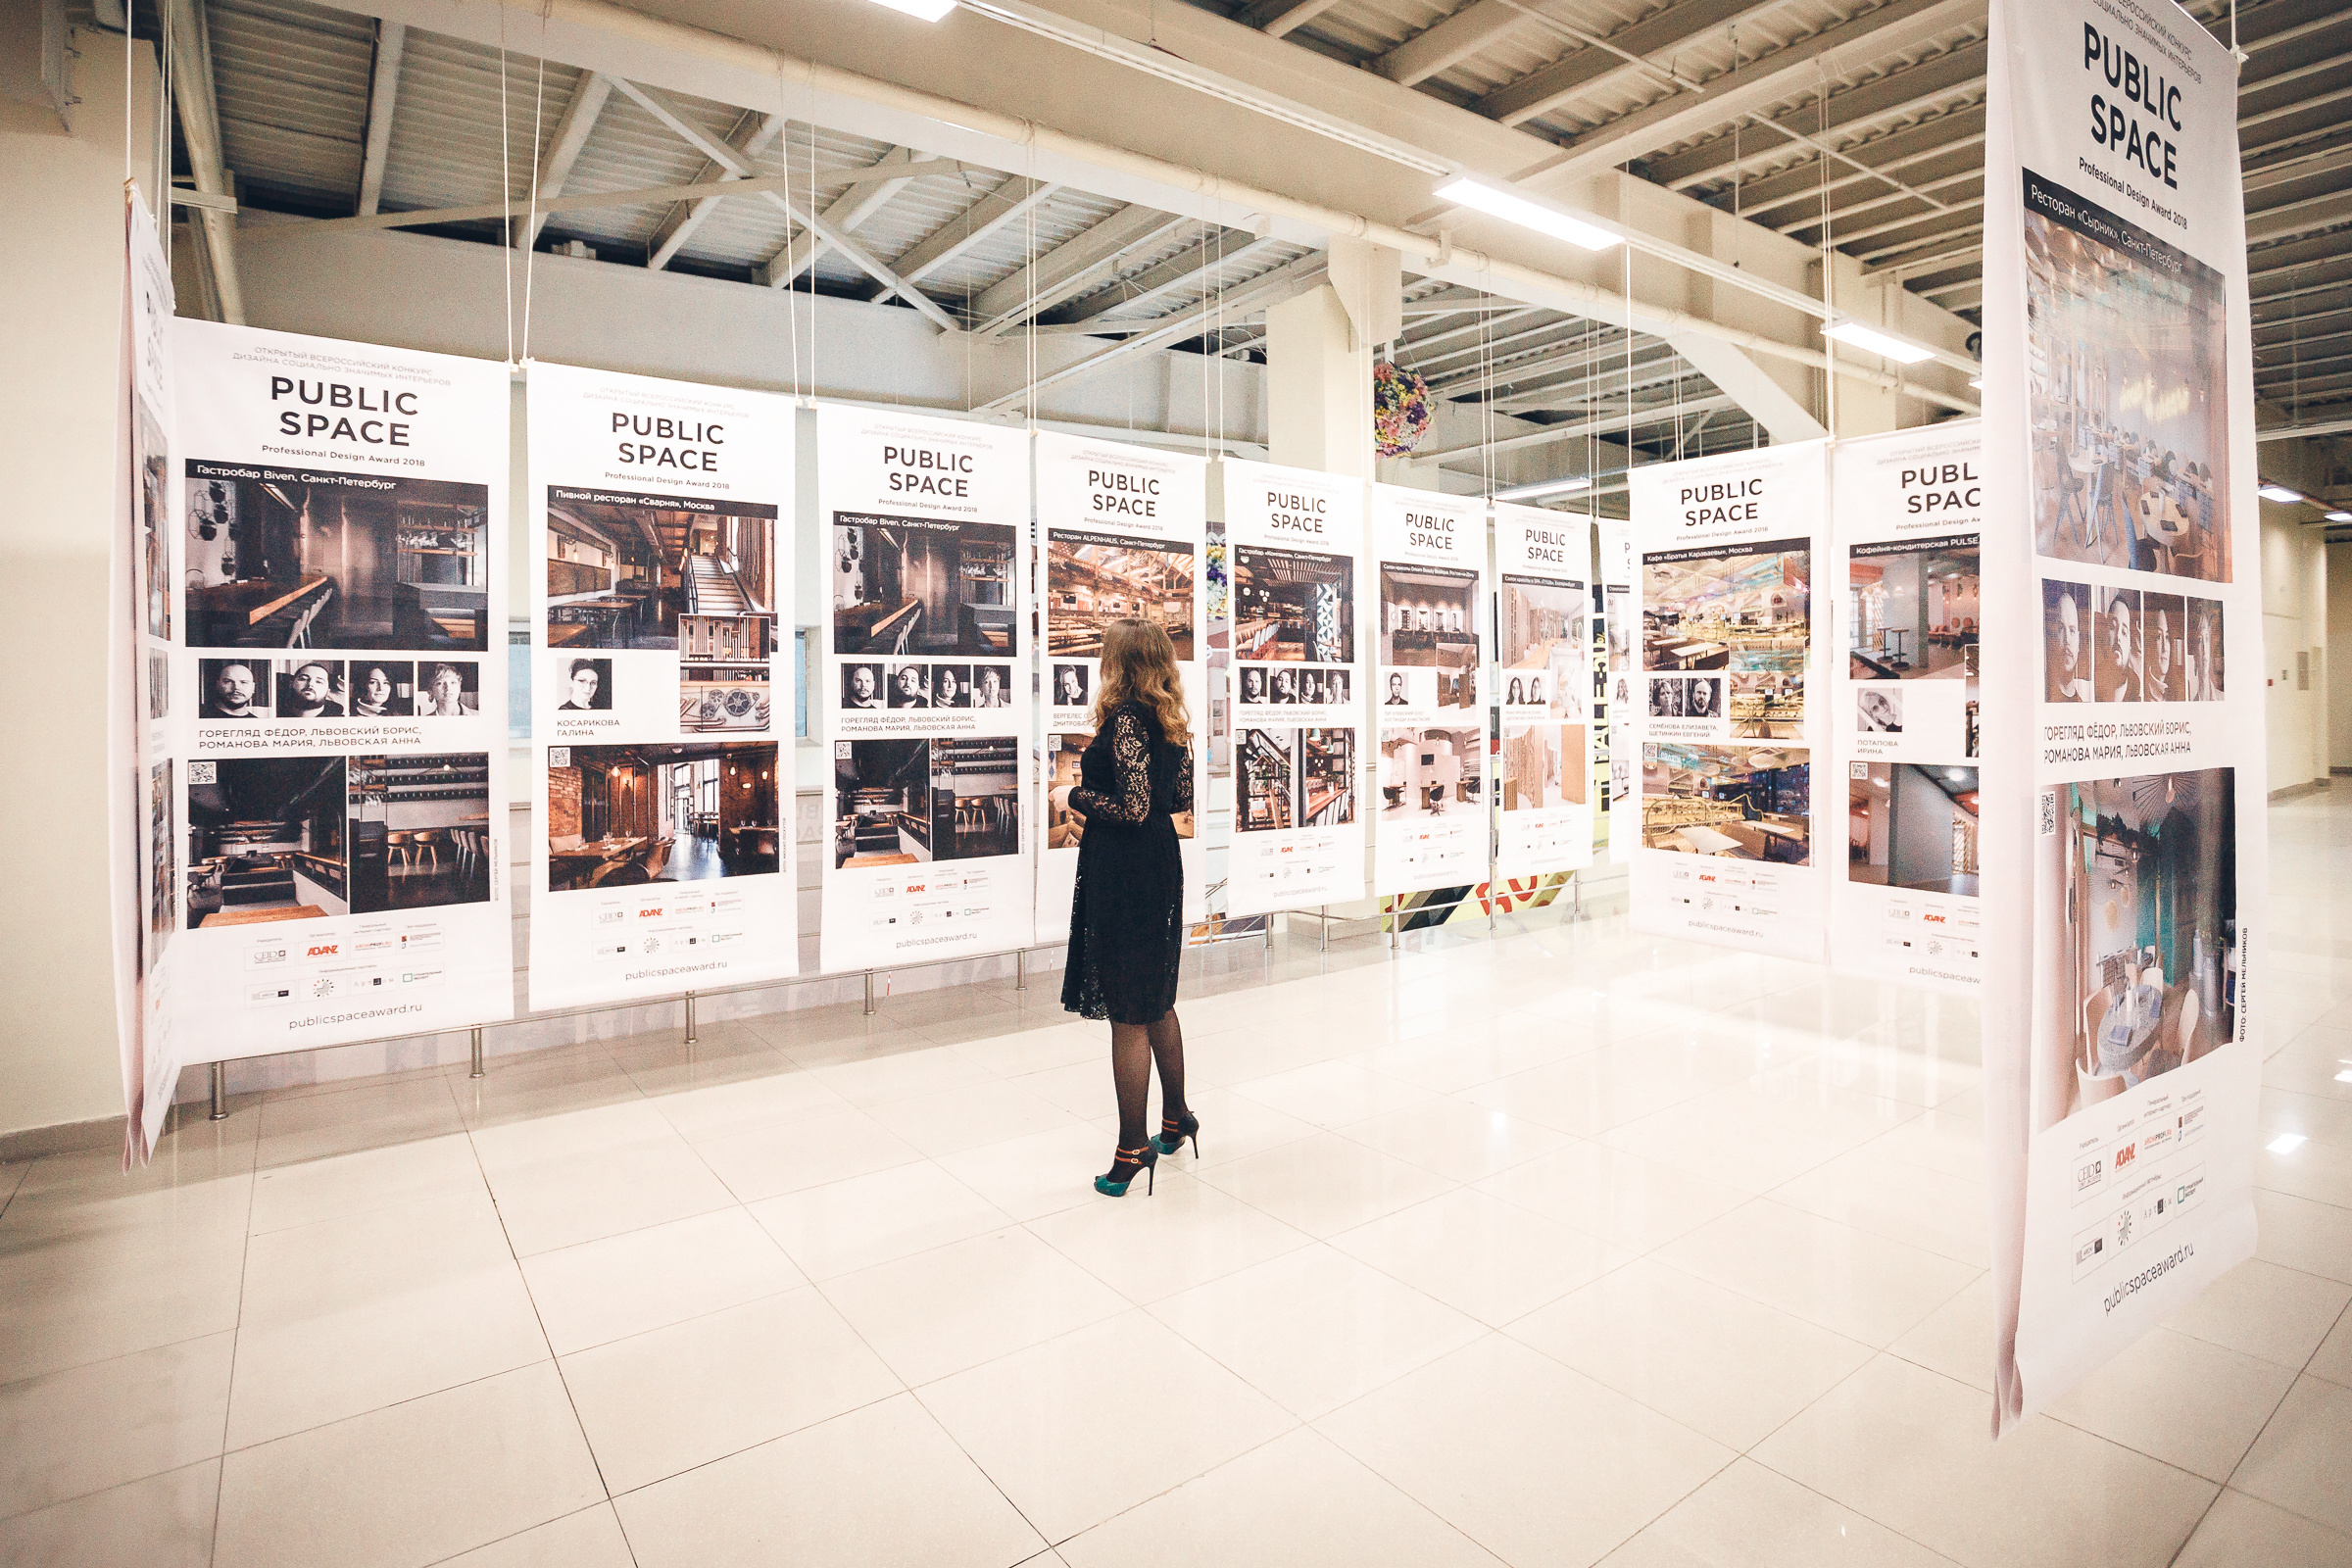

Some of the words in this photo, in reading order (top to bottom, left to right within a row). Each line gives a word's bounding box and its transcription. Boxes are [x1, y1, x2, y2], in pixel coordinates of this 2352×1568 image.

[2083, 22, 2181, 131] PUBLIC
[2090, 94, 2178, 191] SPACE
[2079, 156, 2125, 194] Professional
[2126, 183, 2149, 208] Design
[2151, 199, 2172, 221] Award
[2173, 212, 2187, 230] 2018
[2032, 183, 2076, 220] Ресторан
[2078, 210, 2120, 243] «Сырник»,
[2121, 230, 2182, 273] Санкт-Петербург
[232, 352, 279, 365] ДИЗАЙНА
[282, 358, 342, 372] СОЦИАЛЬНО
[344, 367, 393, 379] ЗНАЧИМЫХ
[395, 372, 451, 386] ИНТЕРЬЕРОВ
[254, 346, 308, 360] ОТКРЫТЫЙ
[310, 354, 390, 370] ВСЕРОССИЙСКИЙ
[392, 366, 432, 376] КОНКУРС
[270, 375, 418, 416] PUBLIC
[279, 411, 410, 447] SPACE
[612, 412, 724, 445] PUBLIC
[262, 444, 326, 459] Professional
[330, 451, 366, 462] Design
[368, 455, 400, 465] Award
[403, 458, 425, 466] 2018
[617, 442, 718, 472] SPACE
[884, 446, 973, 473] PUBLIC
[197, 465, 261, 479] Гастробар
[300, 473, 396, 490] Санкт-Петербург
[605, 471, 655, 483] Professional
[657, 476, 684, 486] Design
[686, 479, 710, 488] Award
[889, 472, 968, 498] SPACE
[1089, 469, 1159, 496] PUBLIC
[1901, 463, 1978, 489] PUBL
[556, 489, 592, 501] Пивной
[593, 494, 636, 505] ресторан
[638, 497, 681, 509] «Сварня»,
[683, 501, 715, 511] Москва
[1267, 491, 1326, 514] PUBLIC
[1681, 478, 1763, 505] PUBLIC
[1907, 487, 1981, 514] SPAC
[878, 499, 918, 508] Professional
[919, 502, 941, 511] Design
[1093, 494, 1155, 516] SPACE
[1685, 503, 1758, 526] SPACE
[839, 514, 878, 526] Гастробар
[902, 519, 960, 532] Санкт-Петербург
[1084, 516, 1116, 526] Professional
[1271, 513, 1323, 533] SPACE
[1405, 513, 1454, 532] PUBLIC
[1895, 520, 1940, 530] Professional
[1942, 517, 1969, 526] Design
[1053, 531, 1081, 541] Ресторан
[1083, 534, 1118, 545] ALPENHAUS,
[1119, 539, 1165, 549] Санкт-Петербург
[1409, 532, 1452, 550] SPACE
[1525, 528, 1566, 546] PUBLIC
[1676, 532, 1710, 541] Professional
[1711, 529, 1732, 538] Design
[1528, 547, 1563, 563] SPACE
[1664, 552, 1688, 561] «Братья
[1728, 546, 1753, 555] Москва
[1856, 541, 1948, 555] Кофейня-кондитерская
[880, 715, 906, 724] ФЁДОР,
[198, 729, 261, 739] ГОРЕГЛЯД
[265, 726, 307, 738] ФЁДОР,
[311, 725, 379, 736] ЛЬВОВСКИЙ
[382, 725, 422, 737] БОРИС,
[2043, 724, 2084, 742] ГОРЕГЛЯД
[2086, 721, 2118, 741] ФЁДОР,
[2119, 720, 2165, 737] ЛЬВОВСКИЙ
[2166, 721, 2192, 736] БОРИС,
[199, 740, 270, 750] РОМАНОВА
[272, 739, 317, 750] МАРИЯ,
[318, 737, 388, 748] ЛЬВОВСКАЯ
[391, 736, 421, 745] АННА
[2044, 747, 2090, 763] РОМАНОВА
[2092, 745, 2124, 761] МАРИЯ,
[2125, 742, 2169, 758] ЛЬВОВСКАЯ
[2170, 741, 2191, 754] АННА
[1688, 920, 1764, 938] publicspaceaward.ru
[896, 933, 978, 949] publicspaceaward.ru
[625, 960, 728, 981] publicspaceaward.ru
[288, 1003, 422, 1030] publicspaceaward.ru
[2103, 1243, 2194, 1316] publicspaceaward.ru
